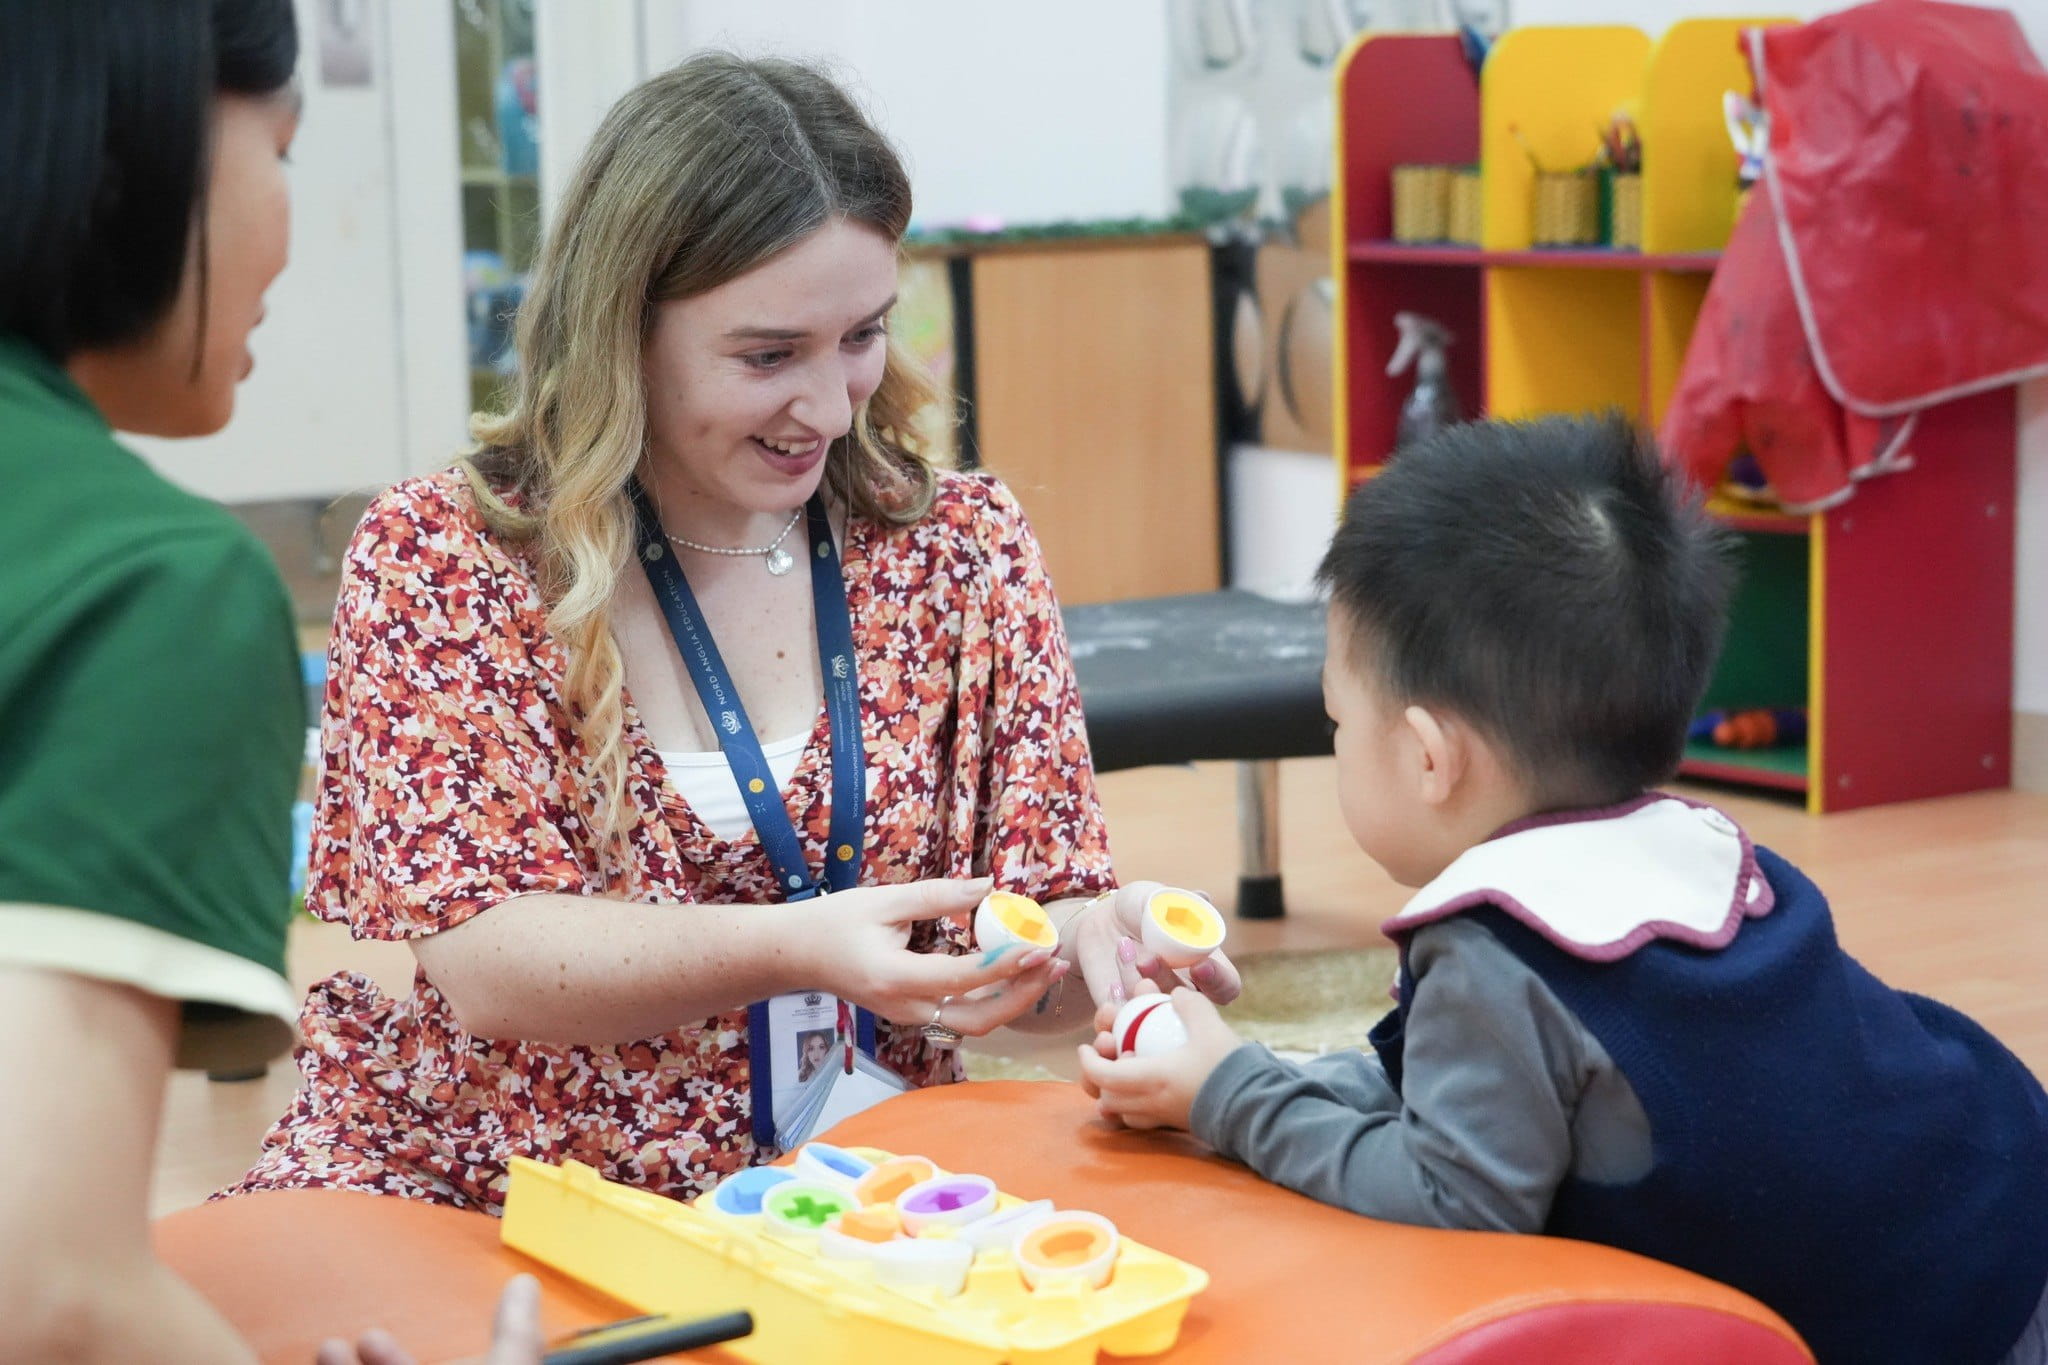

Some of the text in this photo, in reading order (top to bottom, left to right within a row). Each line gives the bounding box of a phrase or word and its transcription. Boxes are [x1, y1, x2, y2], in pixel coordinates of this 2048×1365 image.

[663, 570, 727, 705] NORD ANGLIA EDUCATION
[851, 742, 859, 791] INTERNATIONAL
